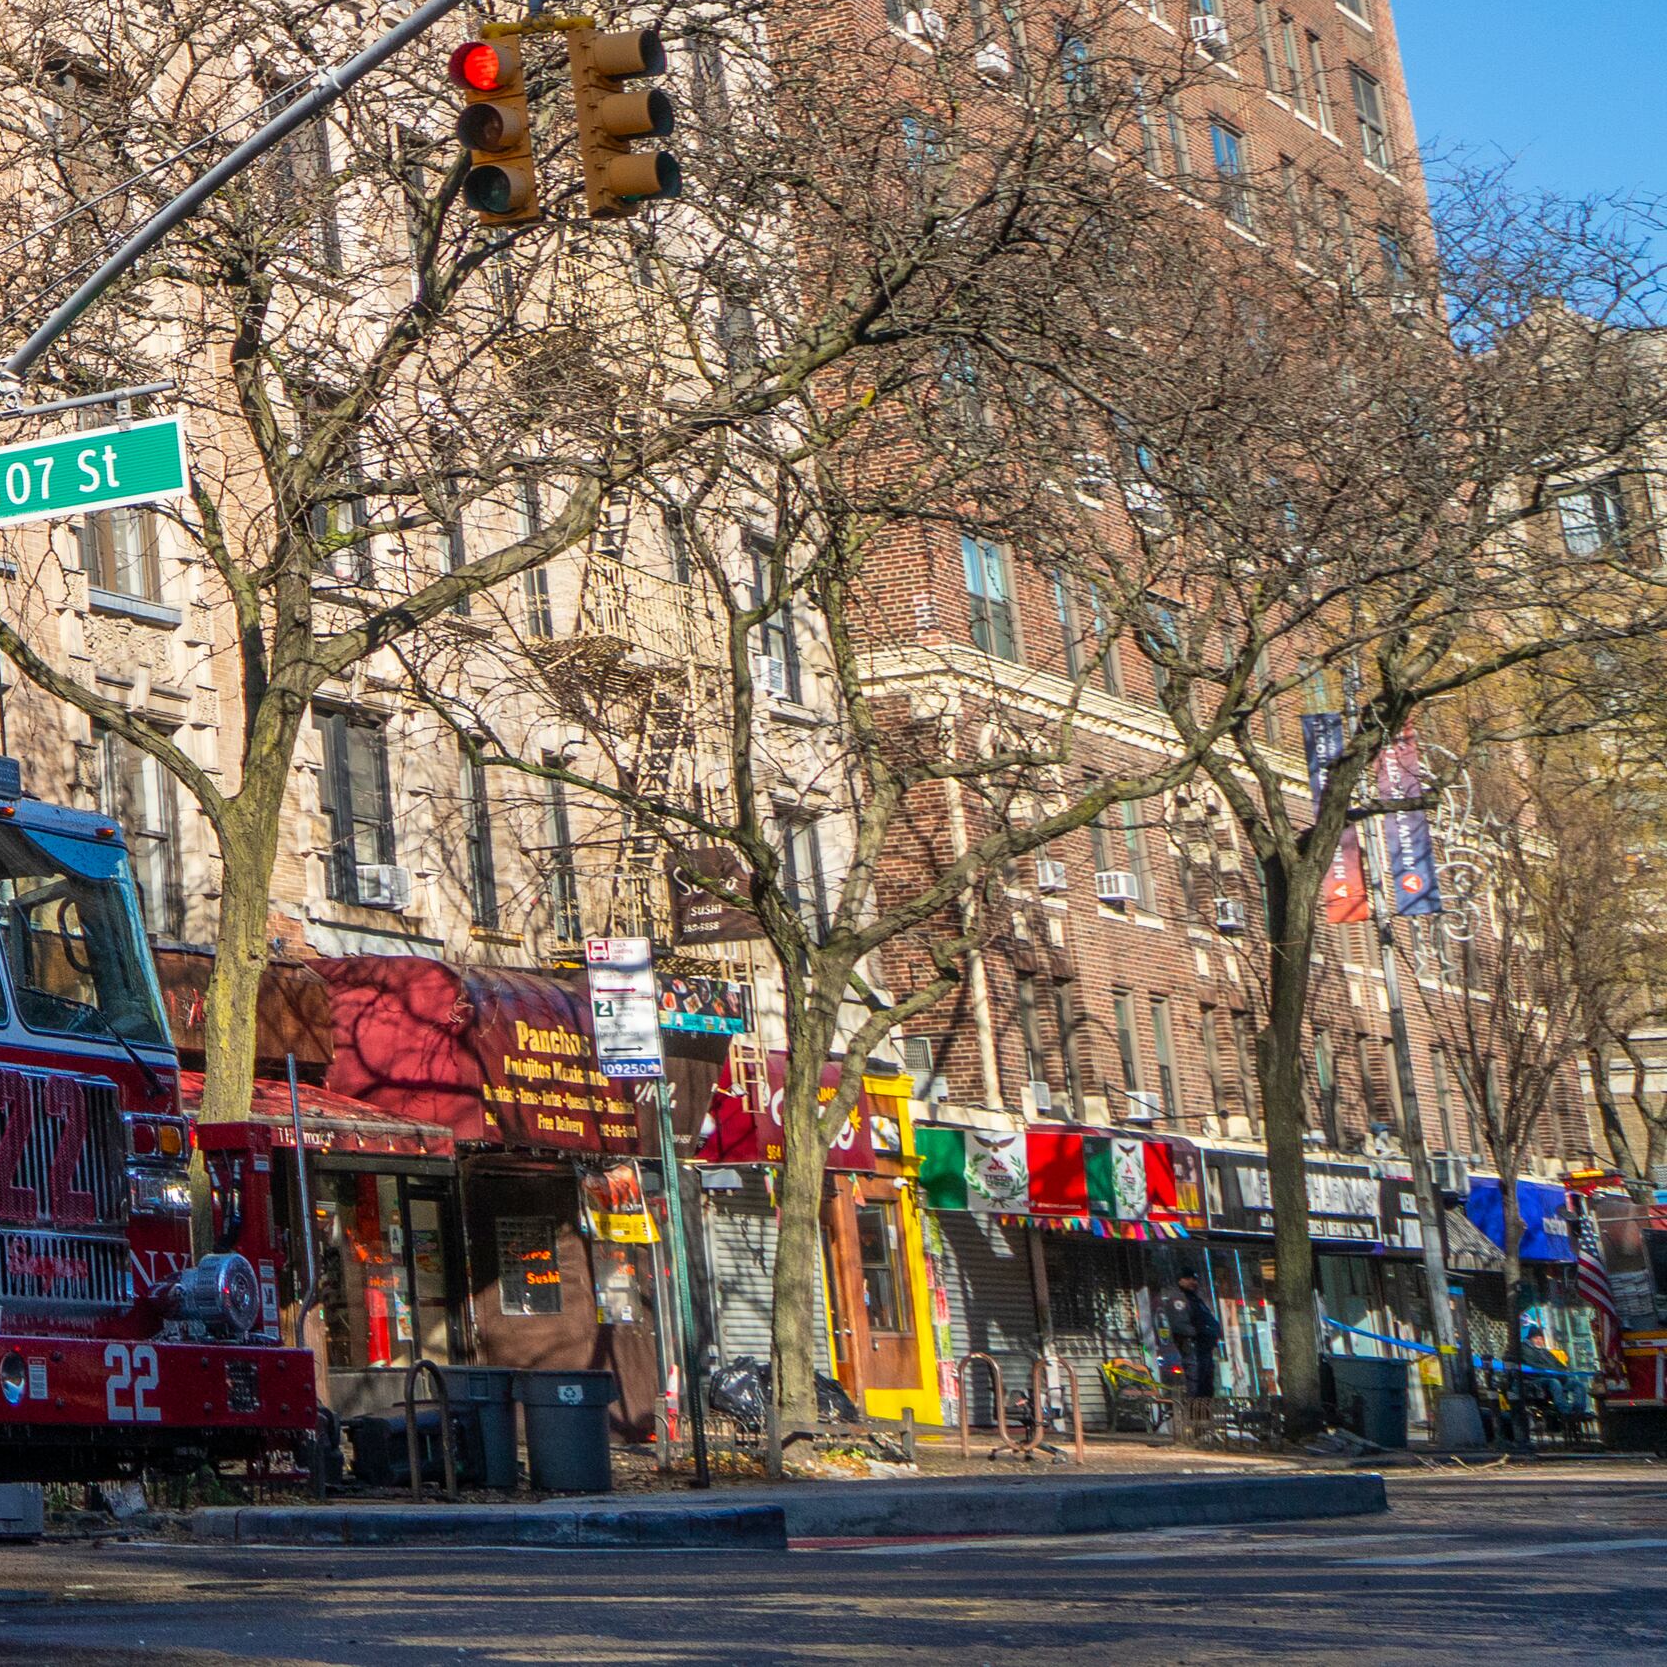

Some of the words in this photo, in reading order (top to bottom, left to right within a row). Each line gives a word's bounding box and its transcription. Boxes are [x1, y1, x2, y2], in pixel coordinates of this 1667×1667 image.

[77, 445, 120, 493] St
[1385, 757, 1401, 783] CITY
[1398, 823, 1413, 853] NEW
[1402, 856, 1416, 870] HI
[690, 904, 722, 916] SUSHI
[598, 1001, 610, 1015] 2
[515, 1020, 591, 1058] Panchos
[503, 1055, 551, 1082] Antojitos
[602, 1063, 647, 1074] 109250
[537, 1113, 554, 1131] Free
[555, 1116, 584, 1136] Delivery
[525, 1271, 560, 1285] Sushi
[103, 1344, 161, 1422] 22
